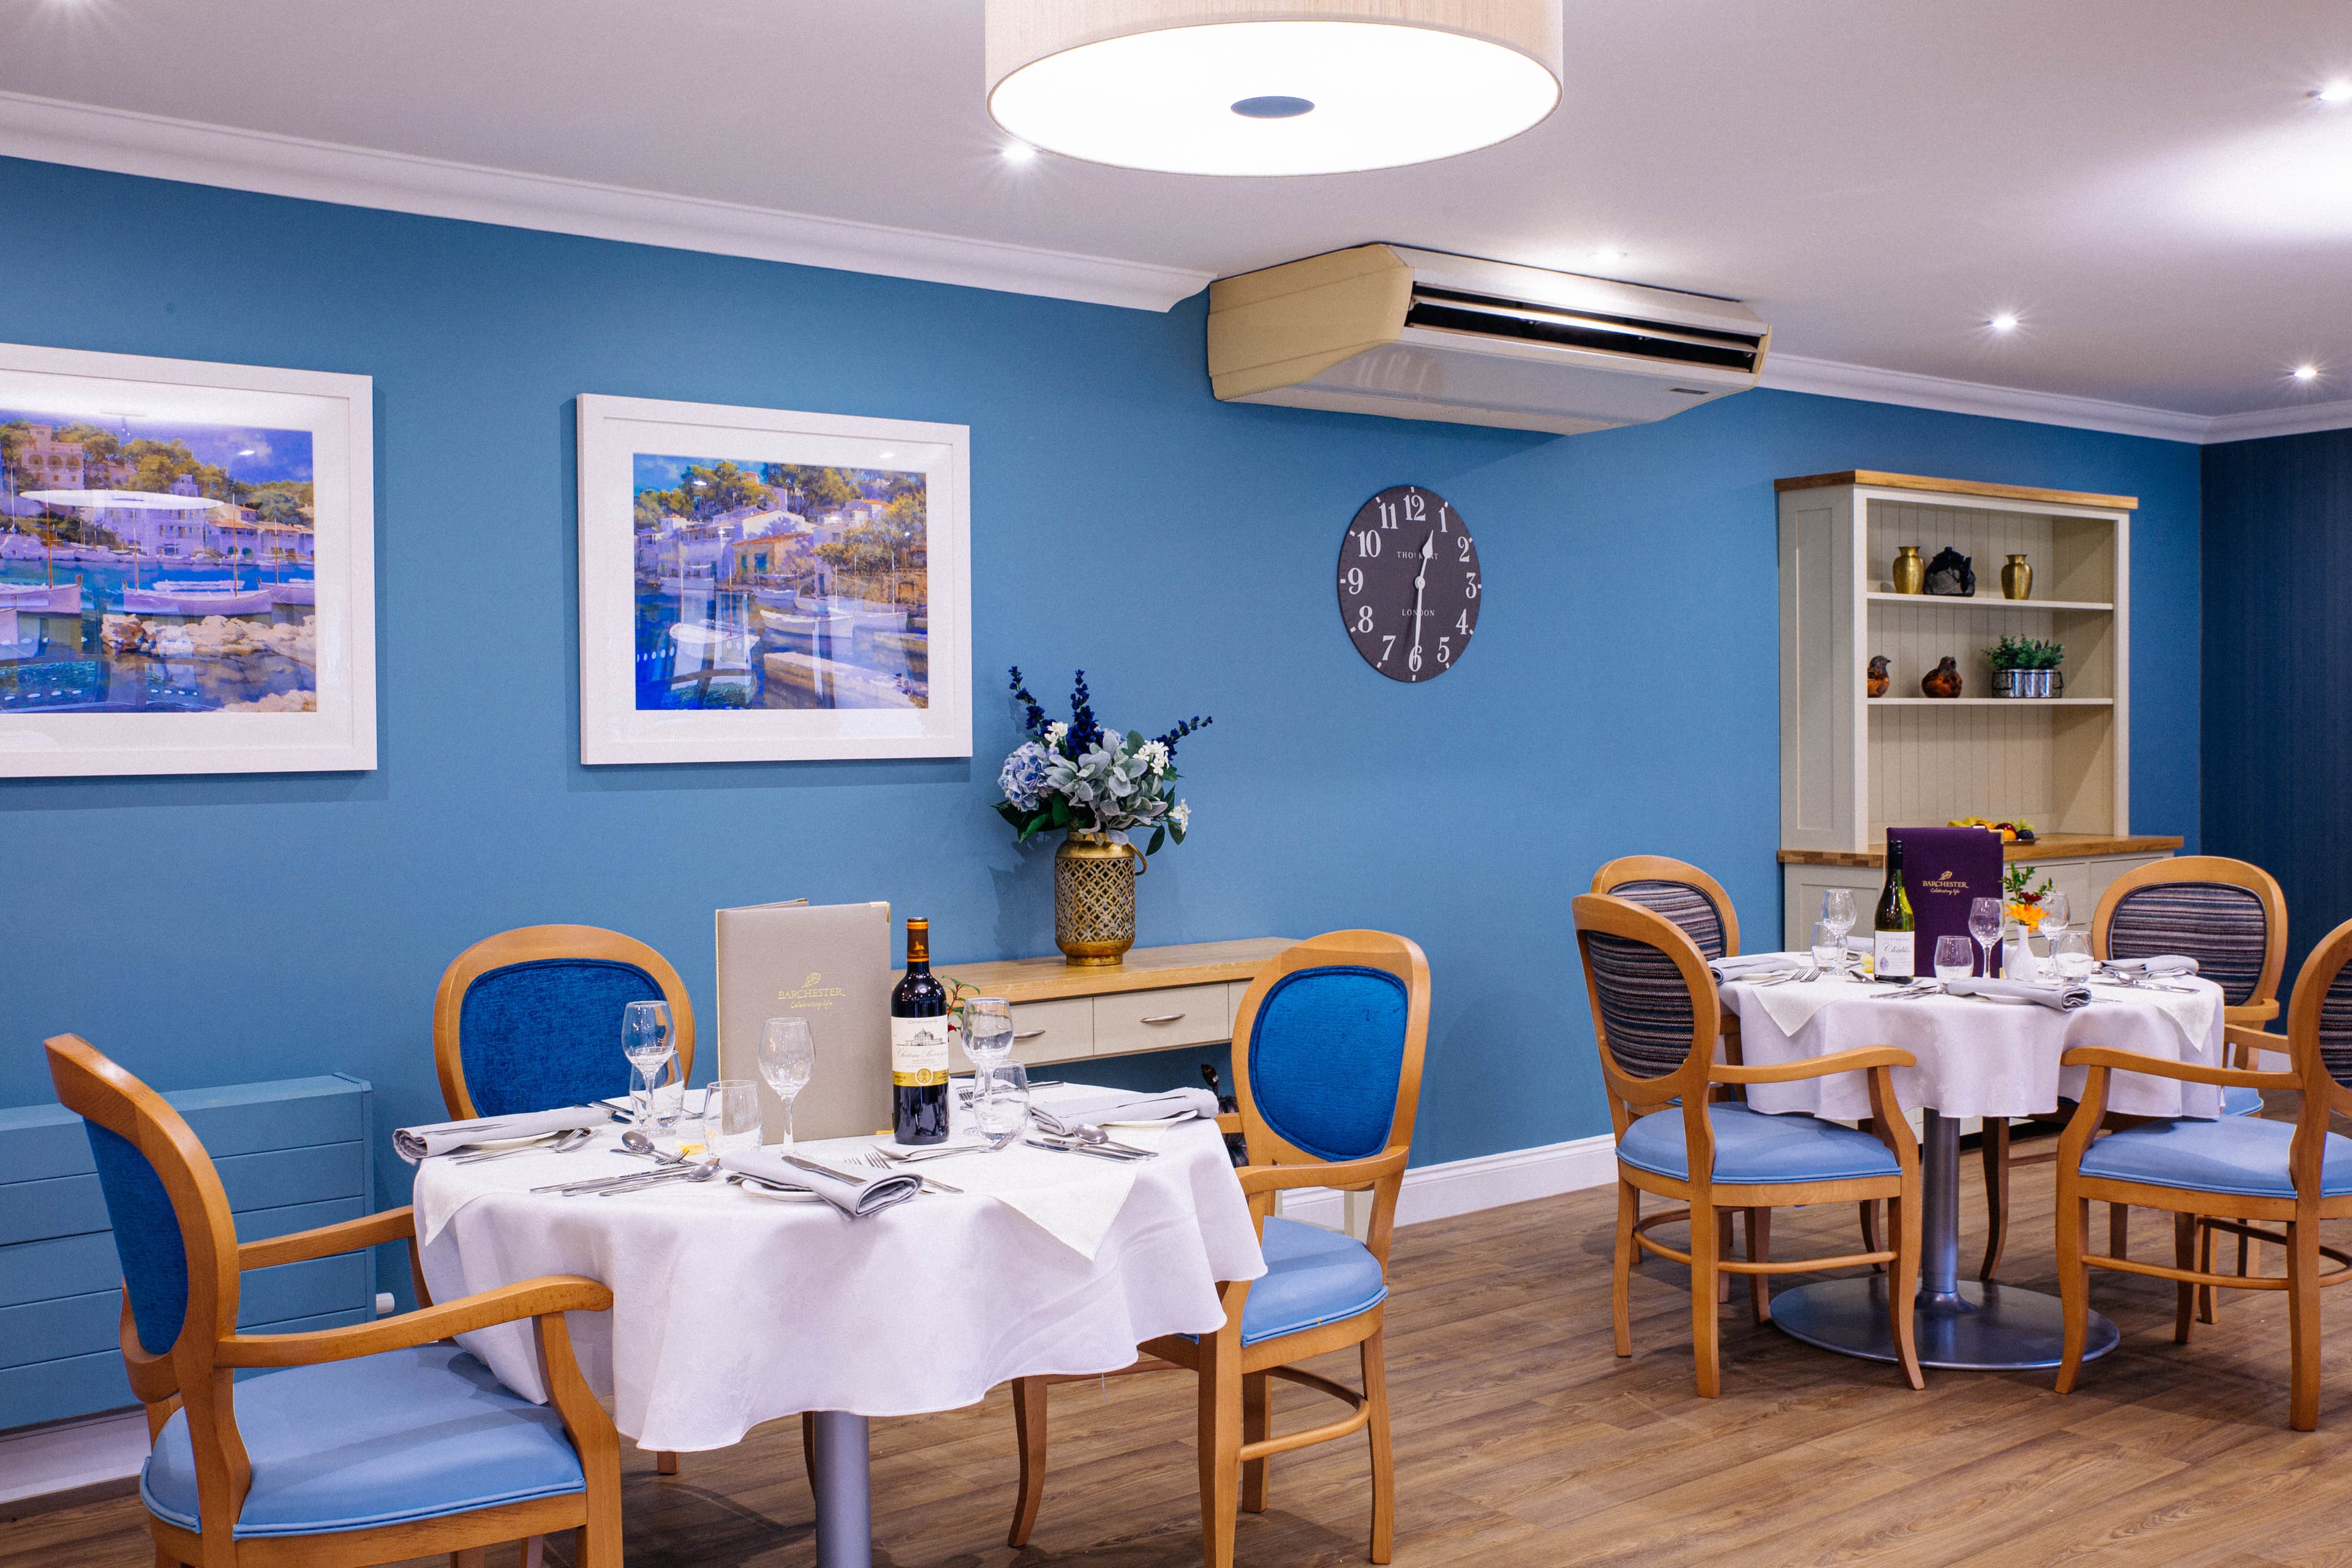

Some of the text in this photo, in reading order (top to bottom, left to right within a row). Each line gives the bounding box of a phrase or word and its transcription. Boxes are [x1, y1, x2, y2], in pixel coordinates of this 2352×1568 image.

[1379, 503, 1398, 529] 11
[1403, 495, 1426, 521] 12
[1439, 507, 1448, 533] 1
[1357, 530, 1381, 557] 10
[1457, 536, 1470, 562] 2
[1348, 567, 1363, 595] 9
[1466, 572, 1477, 598] 3
[1358, 605, 1373, 633] 8
[1455, 608, 1469, 635] 4
[1382, 635, 1396, 661] 7
[1409, 646, 1422, 671] 6
[1437, 636, 1450, 663] 5
[777, 987, 845, 999] BARCHESTER
